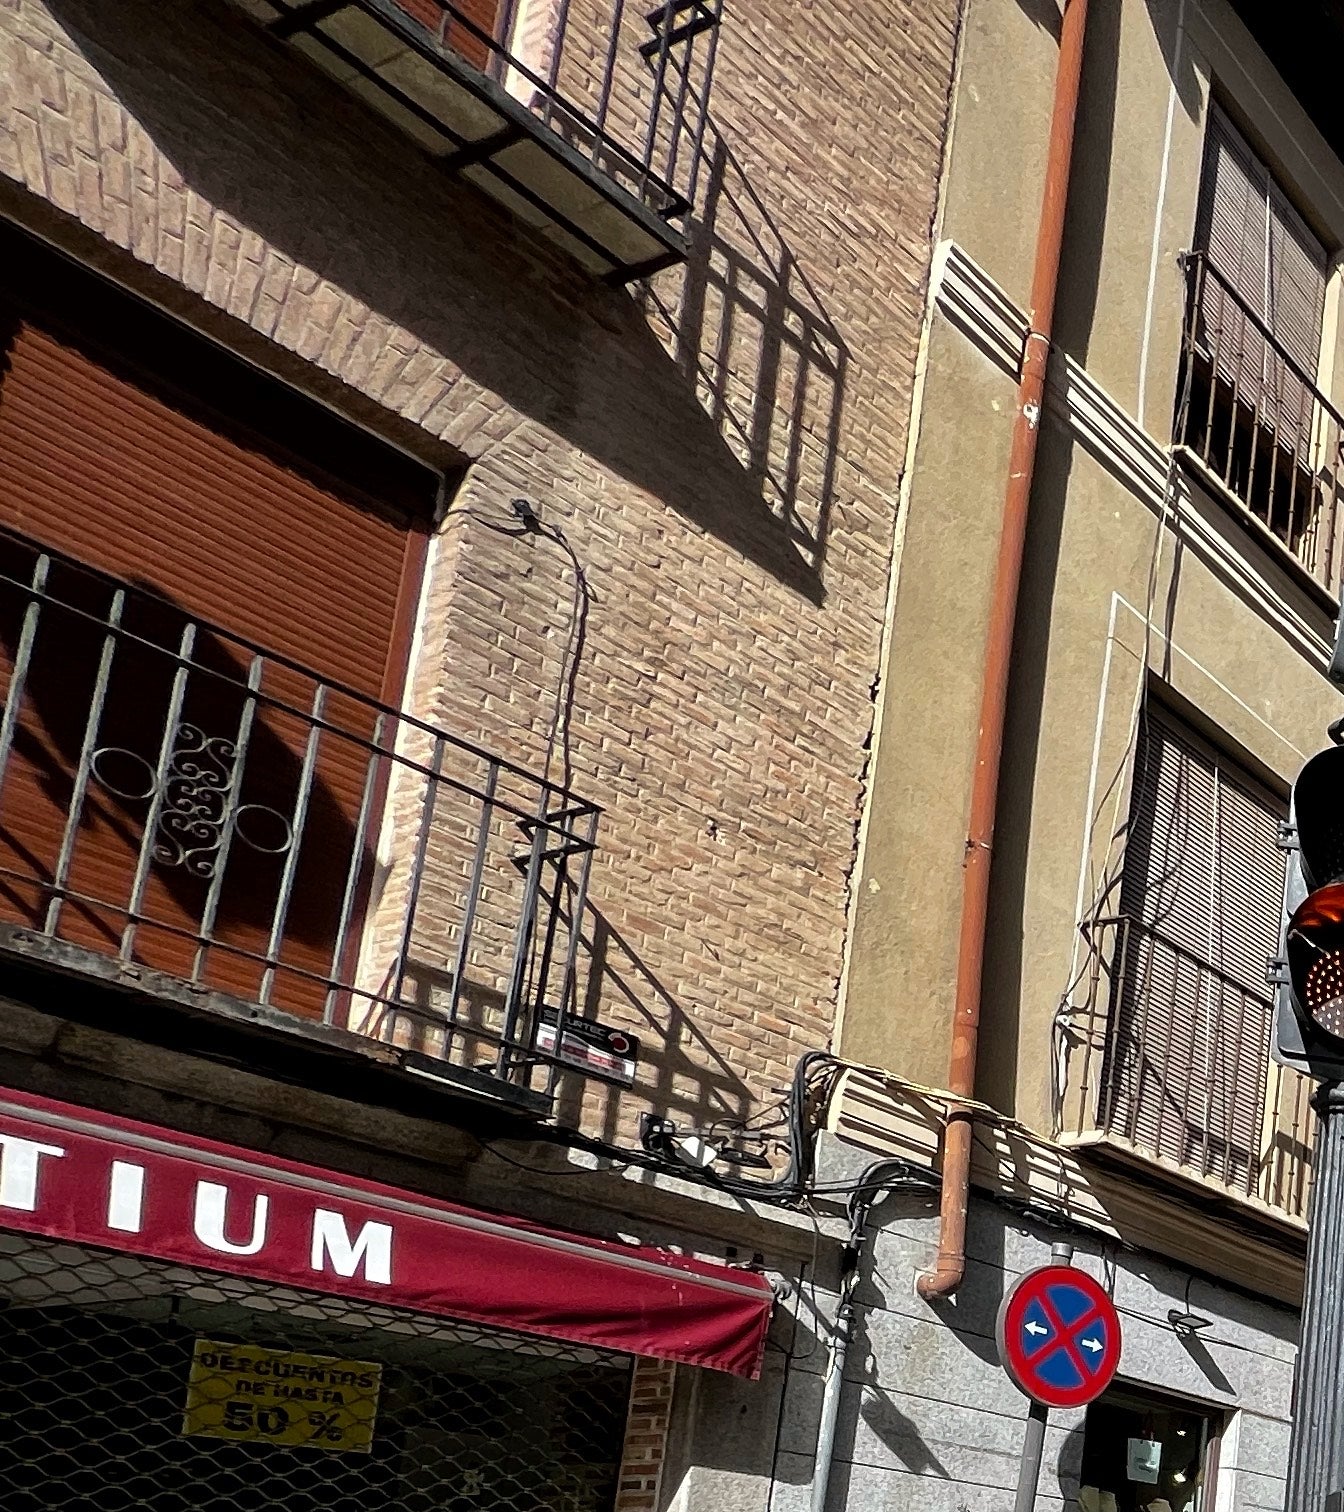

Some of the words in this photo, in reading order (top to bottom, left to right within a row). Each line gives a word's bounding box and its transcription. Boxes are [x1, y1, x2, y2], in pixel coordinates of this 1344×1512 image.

[200, 1352, 373, 1389] DESCUENTOS
[236, 1379, 265, 1396] DE
[223, 1401, 289, 1435] 50
[308, 1411, 344, 1442] %
